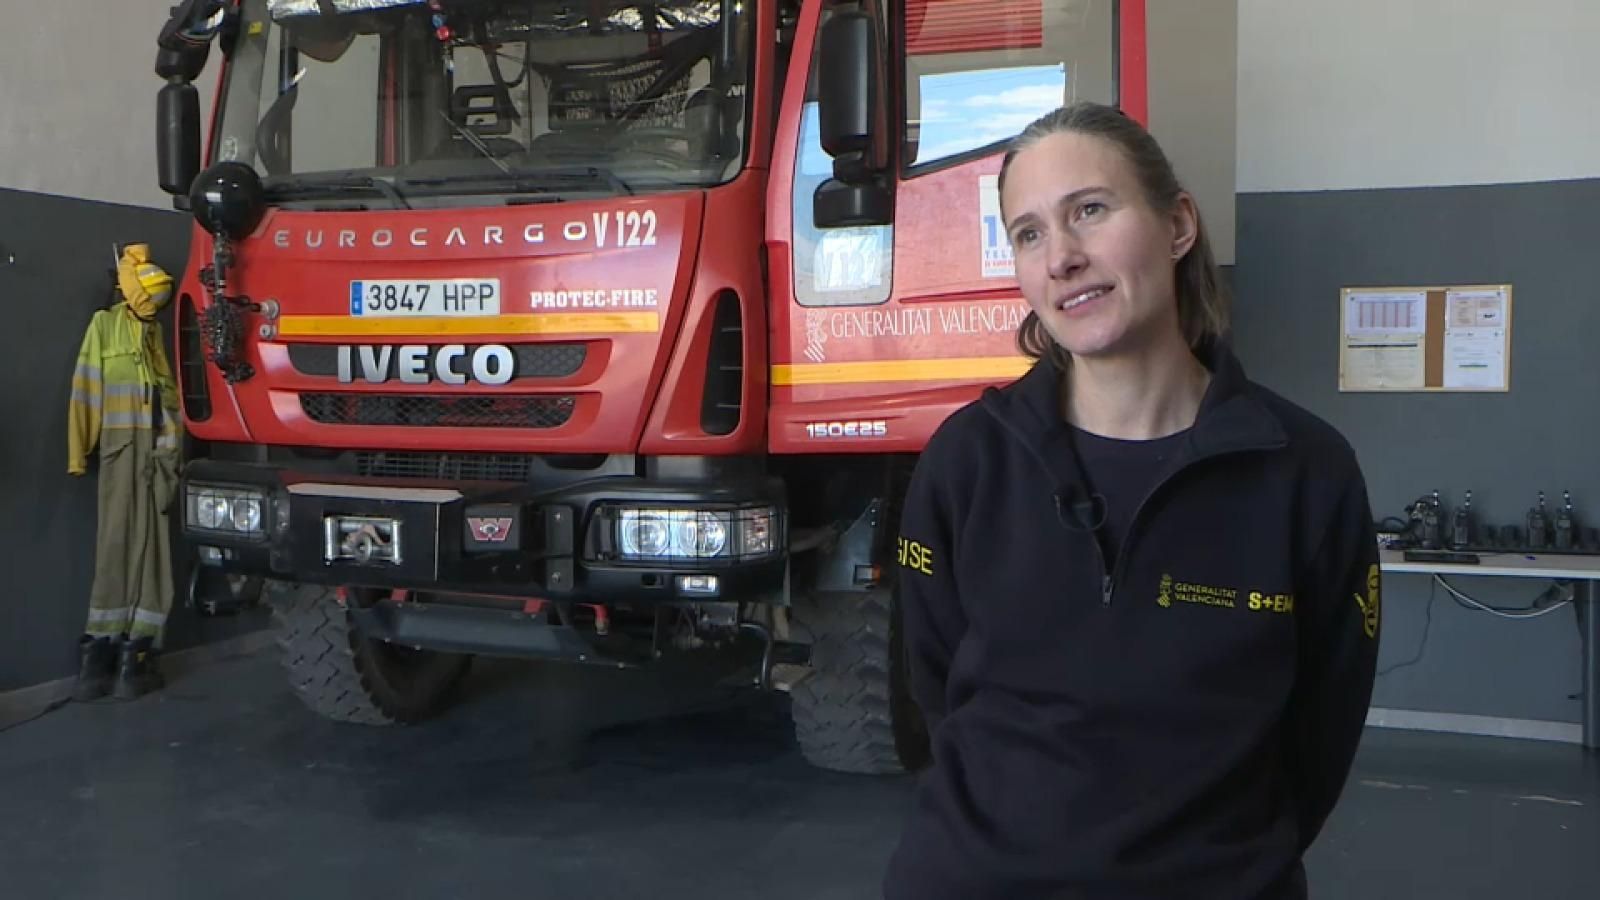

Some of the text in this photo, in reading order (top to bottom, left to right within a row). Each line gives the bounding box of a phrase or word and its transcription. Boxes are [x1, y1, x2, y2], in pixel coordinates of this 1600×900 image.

[274, 221, 588, 248] EUROCARGO
[593, 210, 656, 248] V 122
[368, 283, 494, 311] 3847 HPP
[831, 308, 934, 338] GENERALITAT
[337, 344, 514, 385] IVECO
[806, 421, 887, 440] 150E25
[1174, 582, 1238, 599] GENERALITAT
[1174, 592, 1236, 608] VALENCIANA
